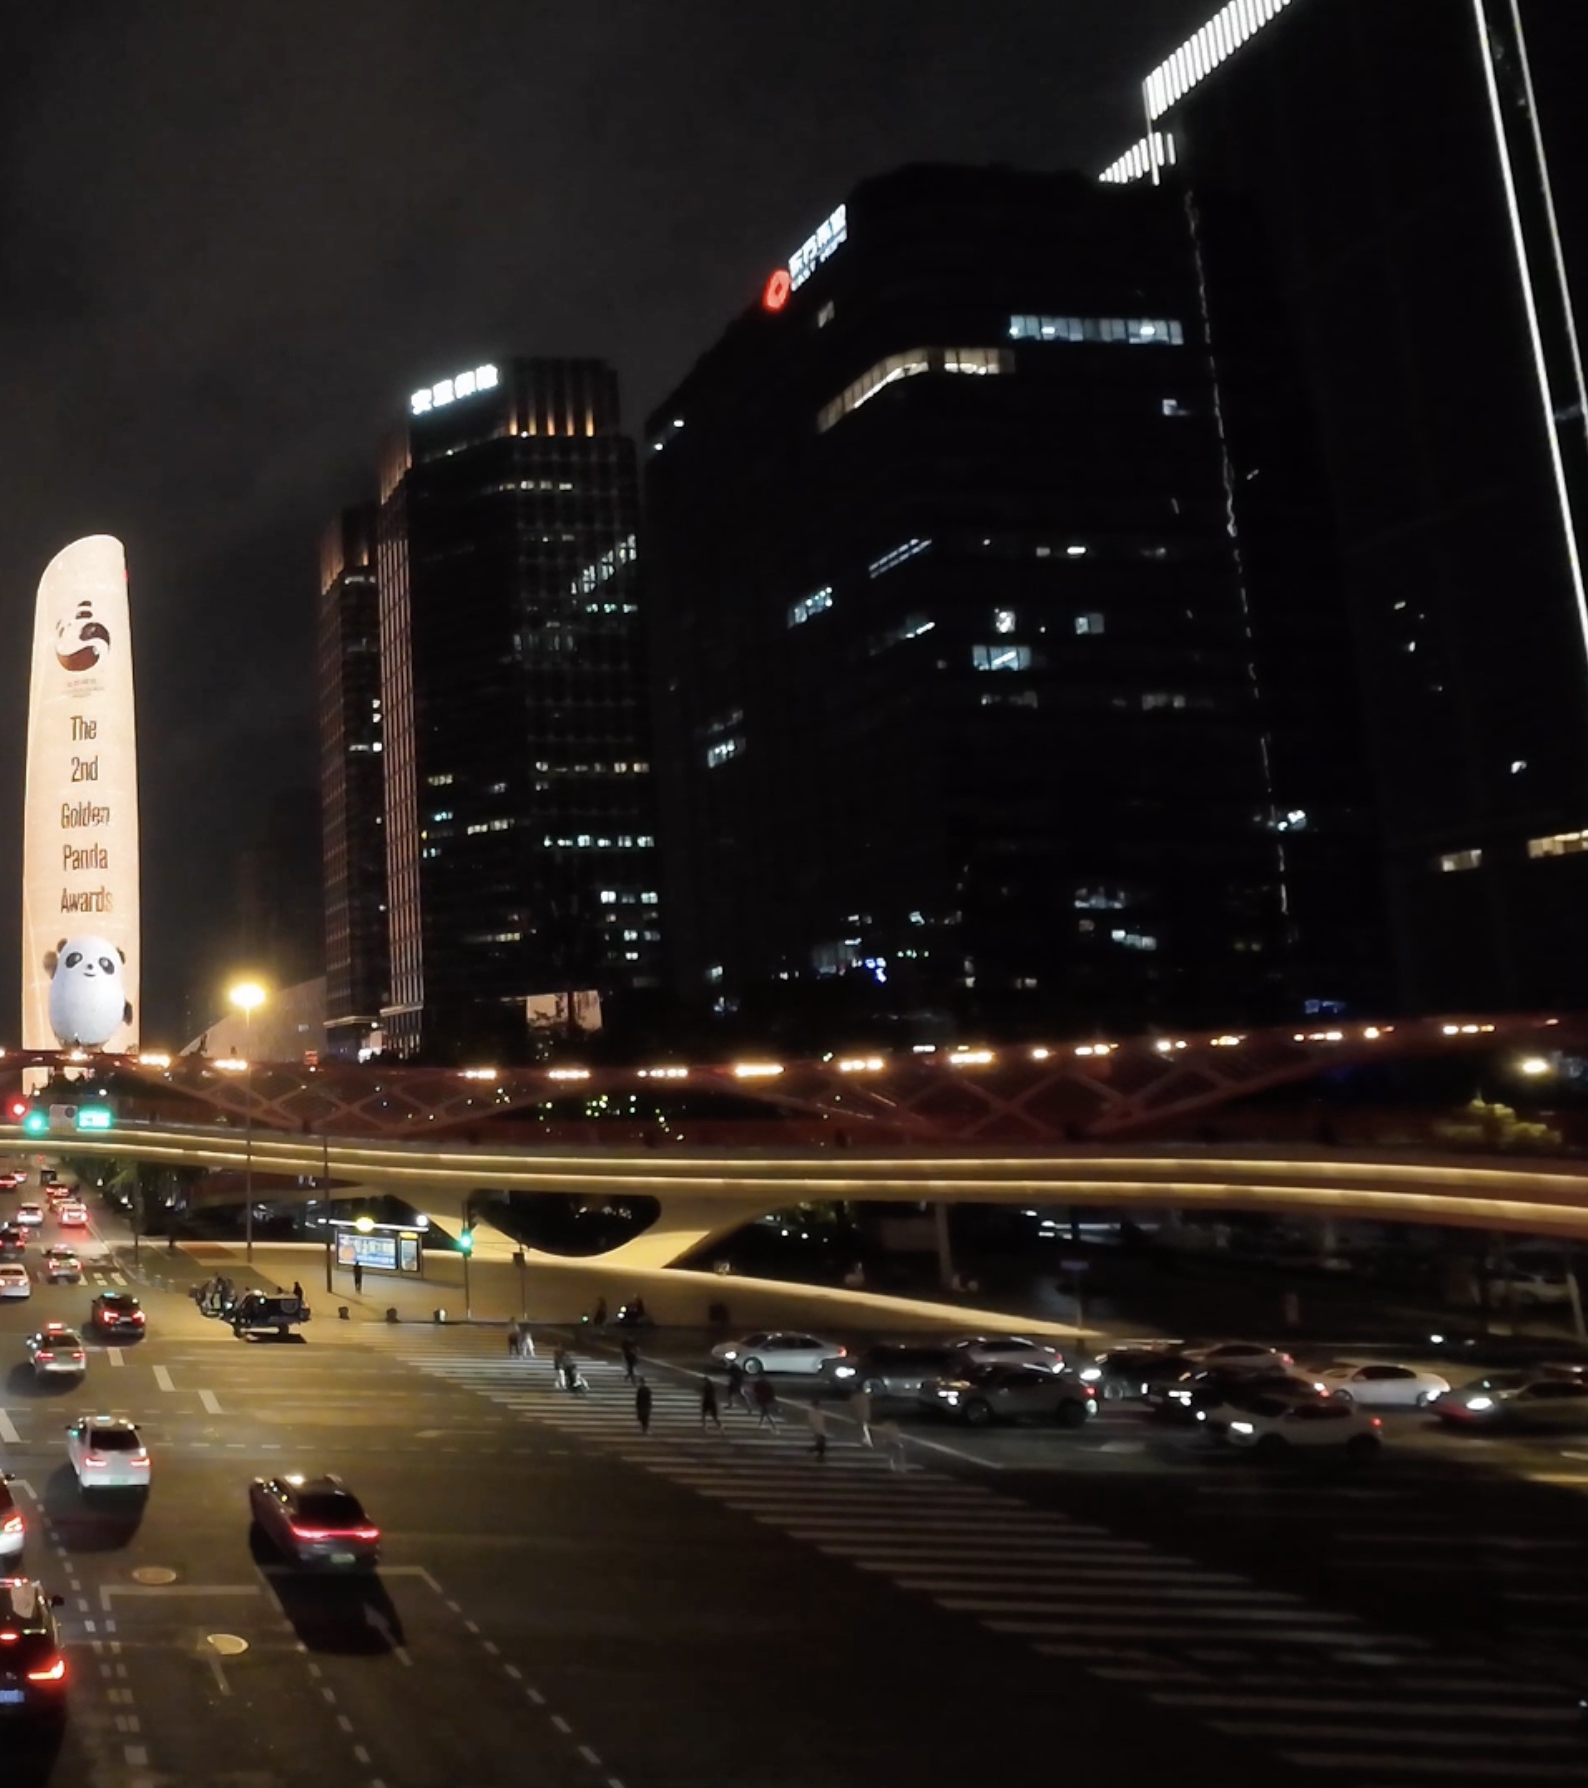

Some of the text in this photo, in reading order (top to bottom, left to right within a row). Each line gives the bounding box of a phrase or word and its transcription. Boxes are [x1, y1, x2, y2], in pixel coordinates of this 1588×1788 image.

[70, 715, 97, 741] The
[71, 755, 99, 782] 2nd
[61, 801, 111, 829] Golden
[63, 842, 108, 871] Panda
[61, 885, 114, 913] Awards
